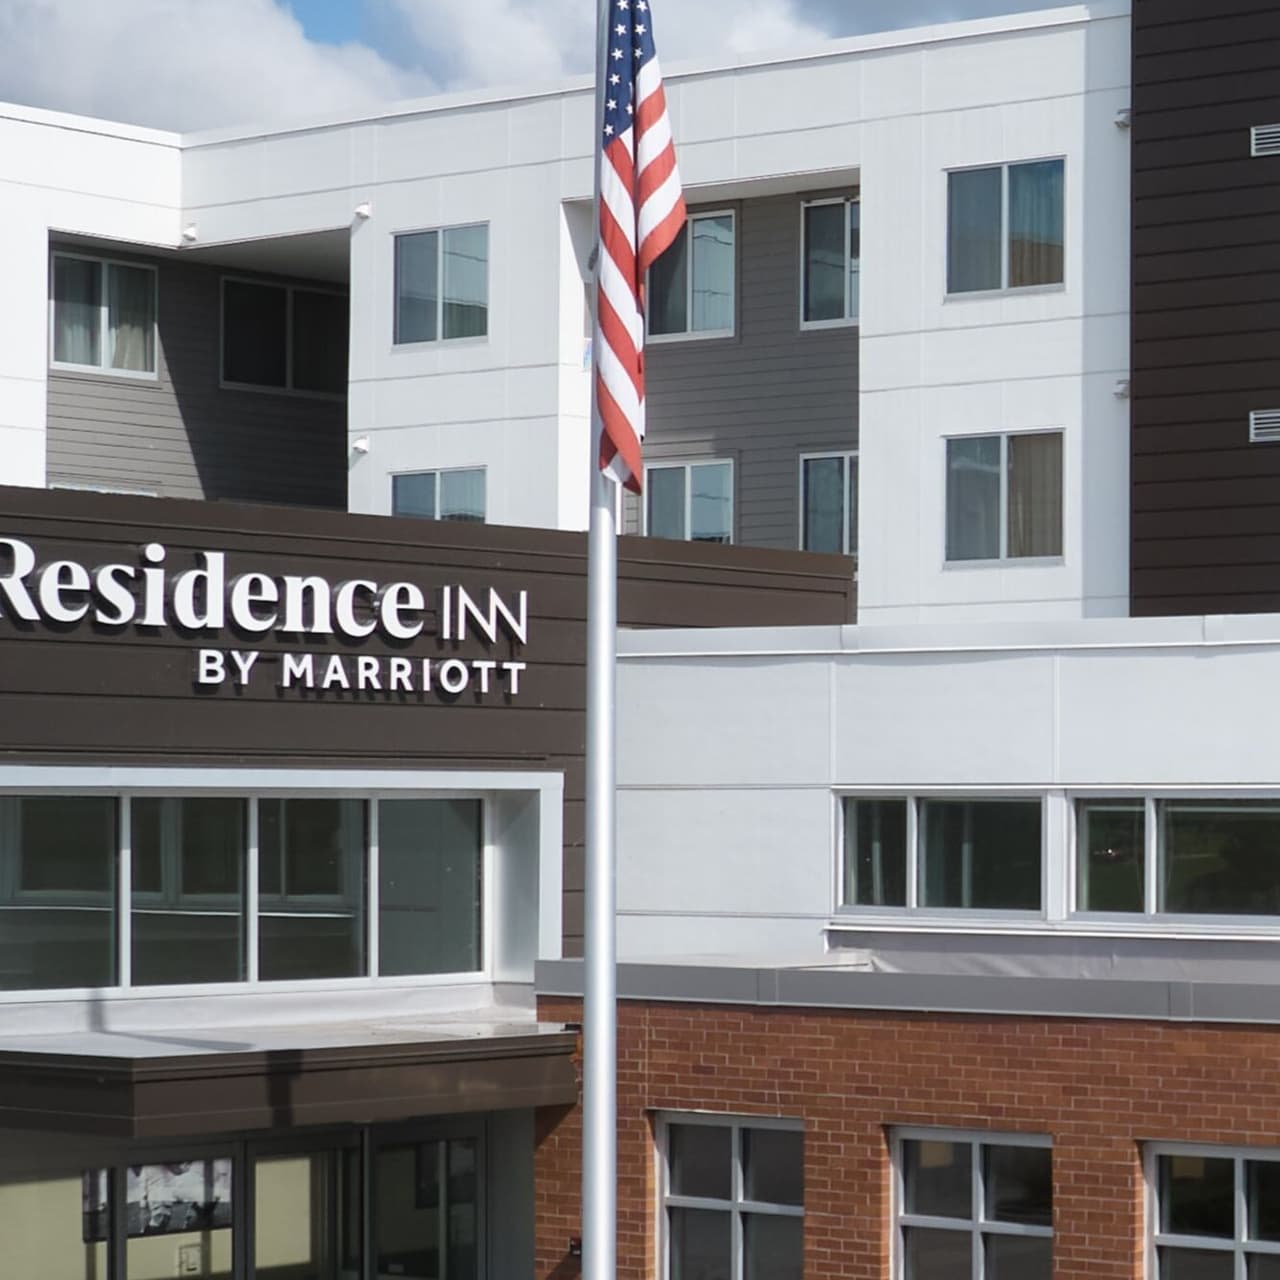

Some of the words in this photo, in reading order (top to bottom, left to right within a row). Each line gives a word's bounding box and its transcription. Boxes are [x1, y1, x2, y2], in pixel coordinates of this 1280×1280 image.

[443, 585, 528, 644] INN
[198, 649, 259, 685] BY
[282, 654, 527, 694] MARRIOTT
